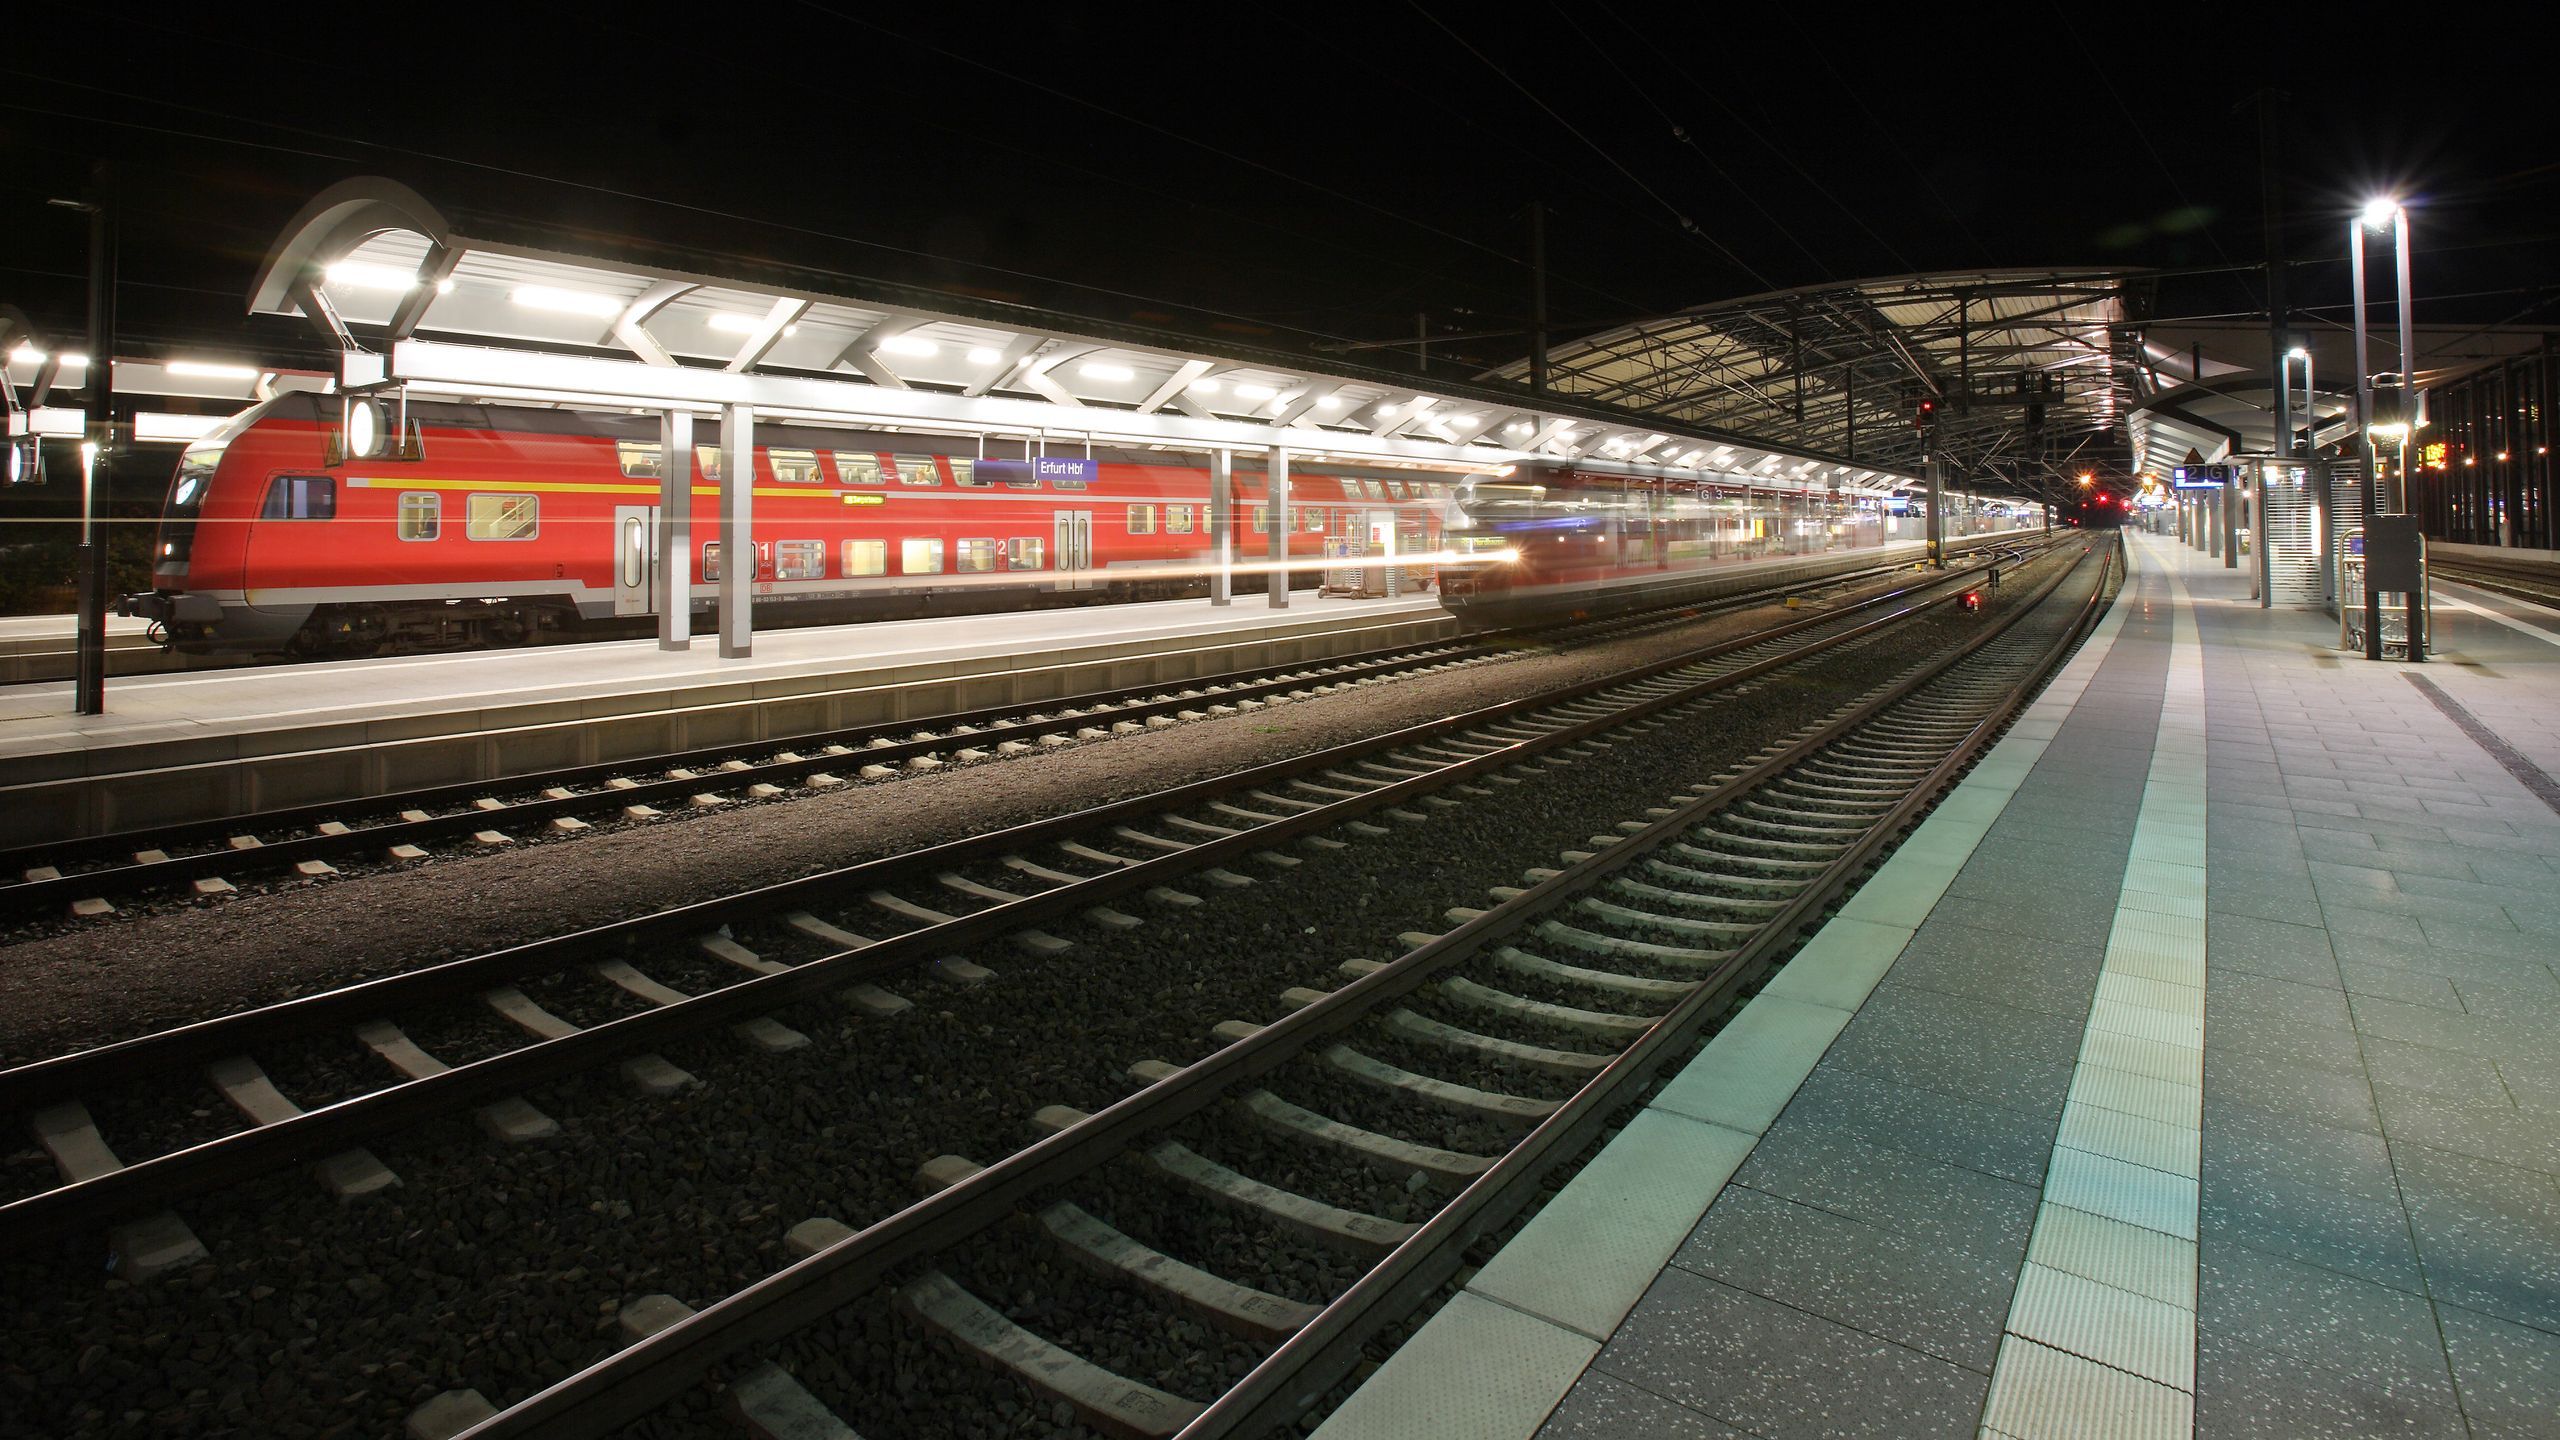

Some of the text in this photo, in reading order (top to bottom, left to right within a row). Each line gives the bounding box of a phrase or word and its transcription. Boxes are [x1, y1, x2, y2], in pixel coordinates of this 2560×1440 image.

[1040, 461, 1084, 475] Erfurt Hbf
[2187, 467, 2223, 479] 2 G
[1701, 489, 1723, 500] G 3
[760, 542, 769, 561] 1
[998, 540, 1007, 555] 2
[761, 584, 772, 592] DB
